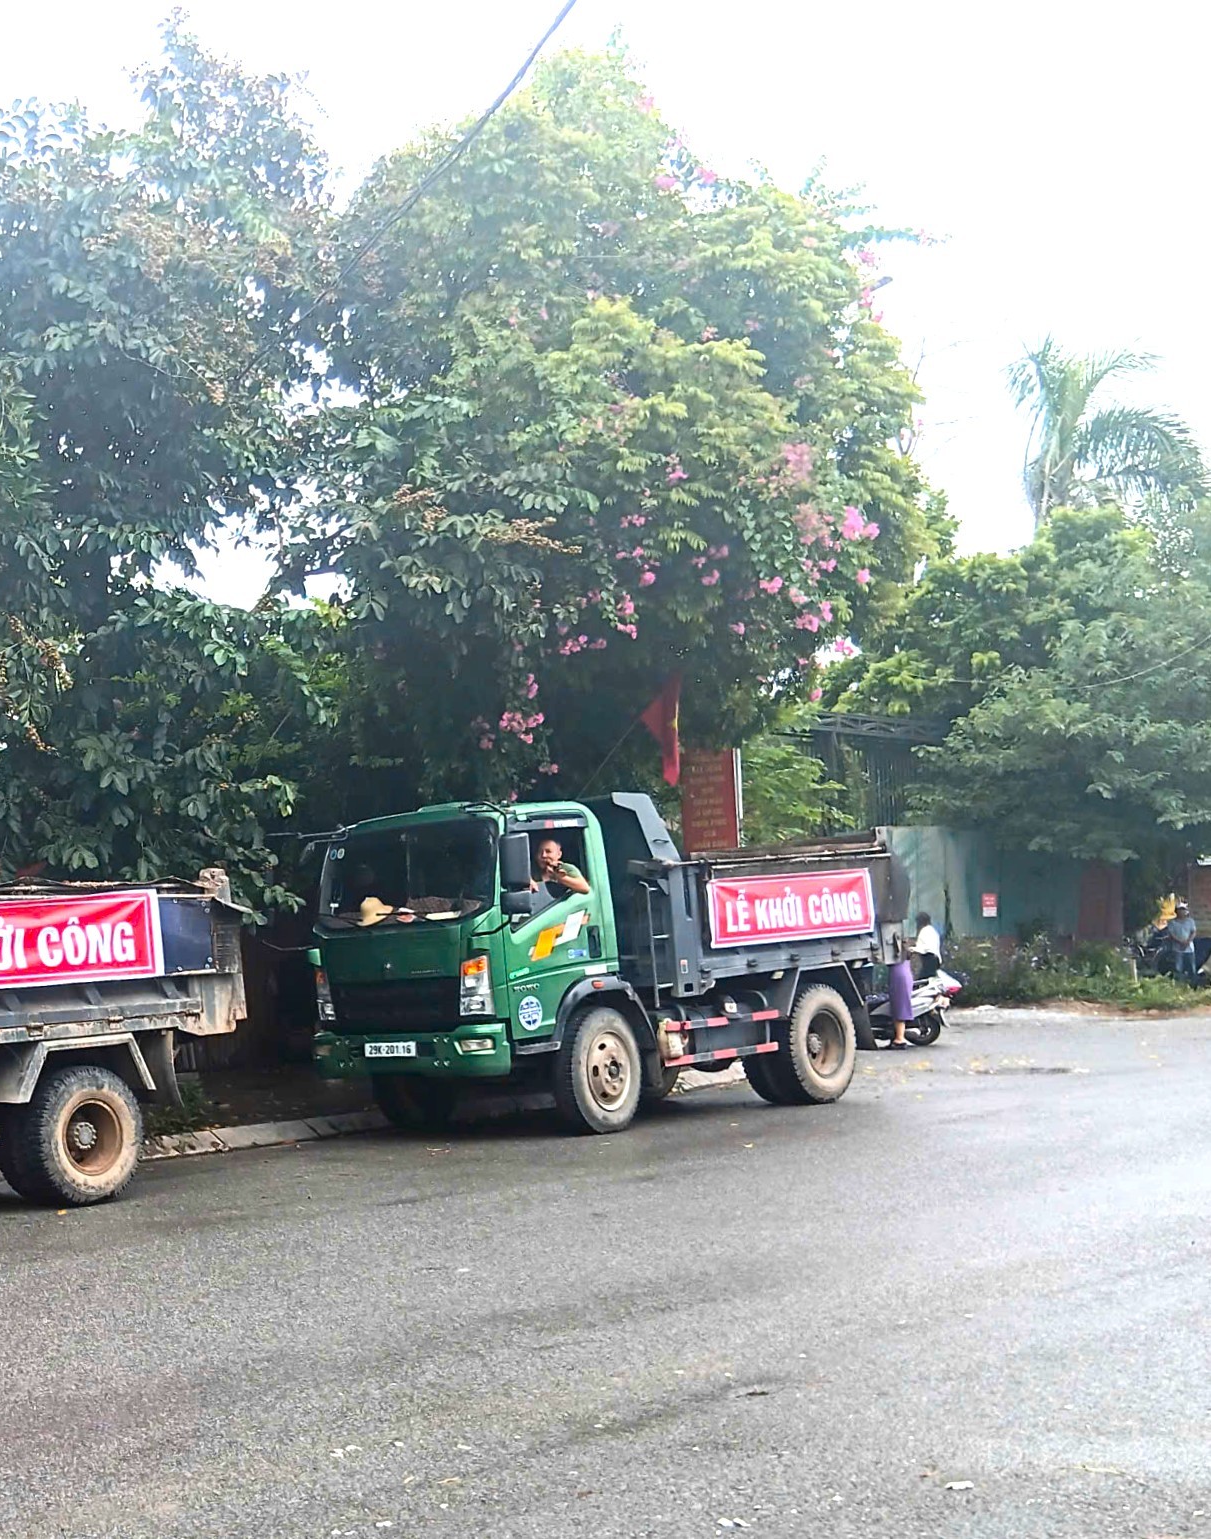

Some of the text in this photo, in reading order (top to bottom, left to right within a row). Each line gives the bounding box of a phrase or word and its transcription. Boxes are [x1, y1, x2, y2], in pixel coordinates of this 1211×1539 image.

[726, 887, 863, 932] LỄ KHỞI CÔNG
[37, 917, 136, 967] CÔNG
